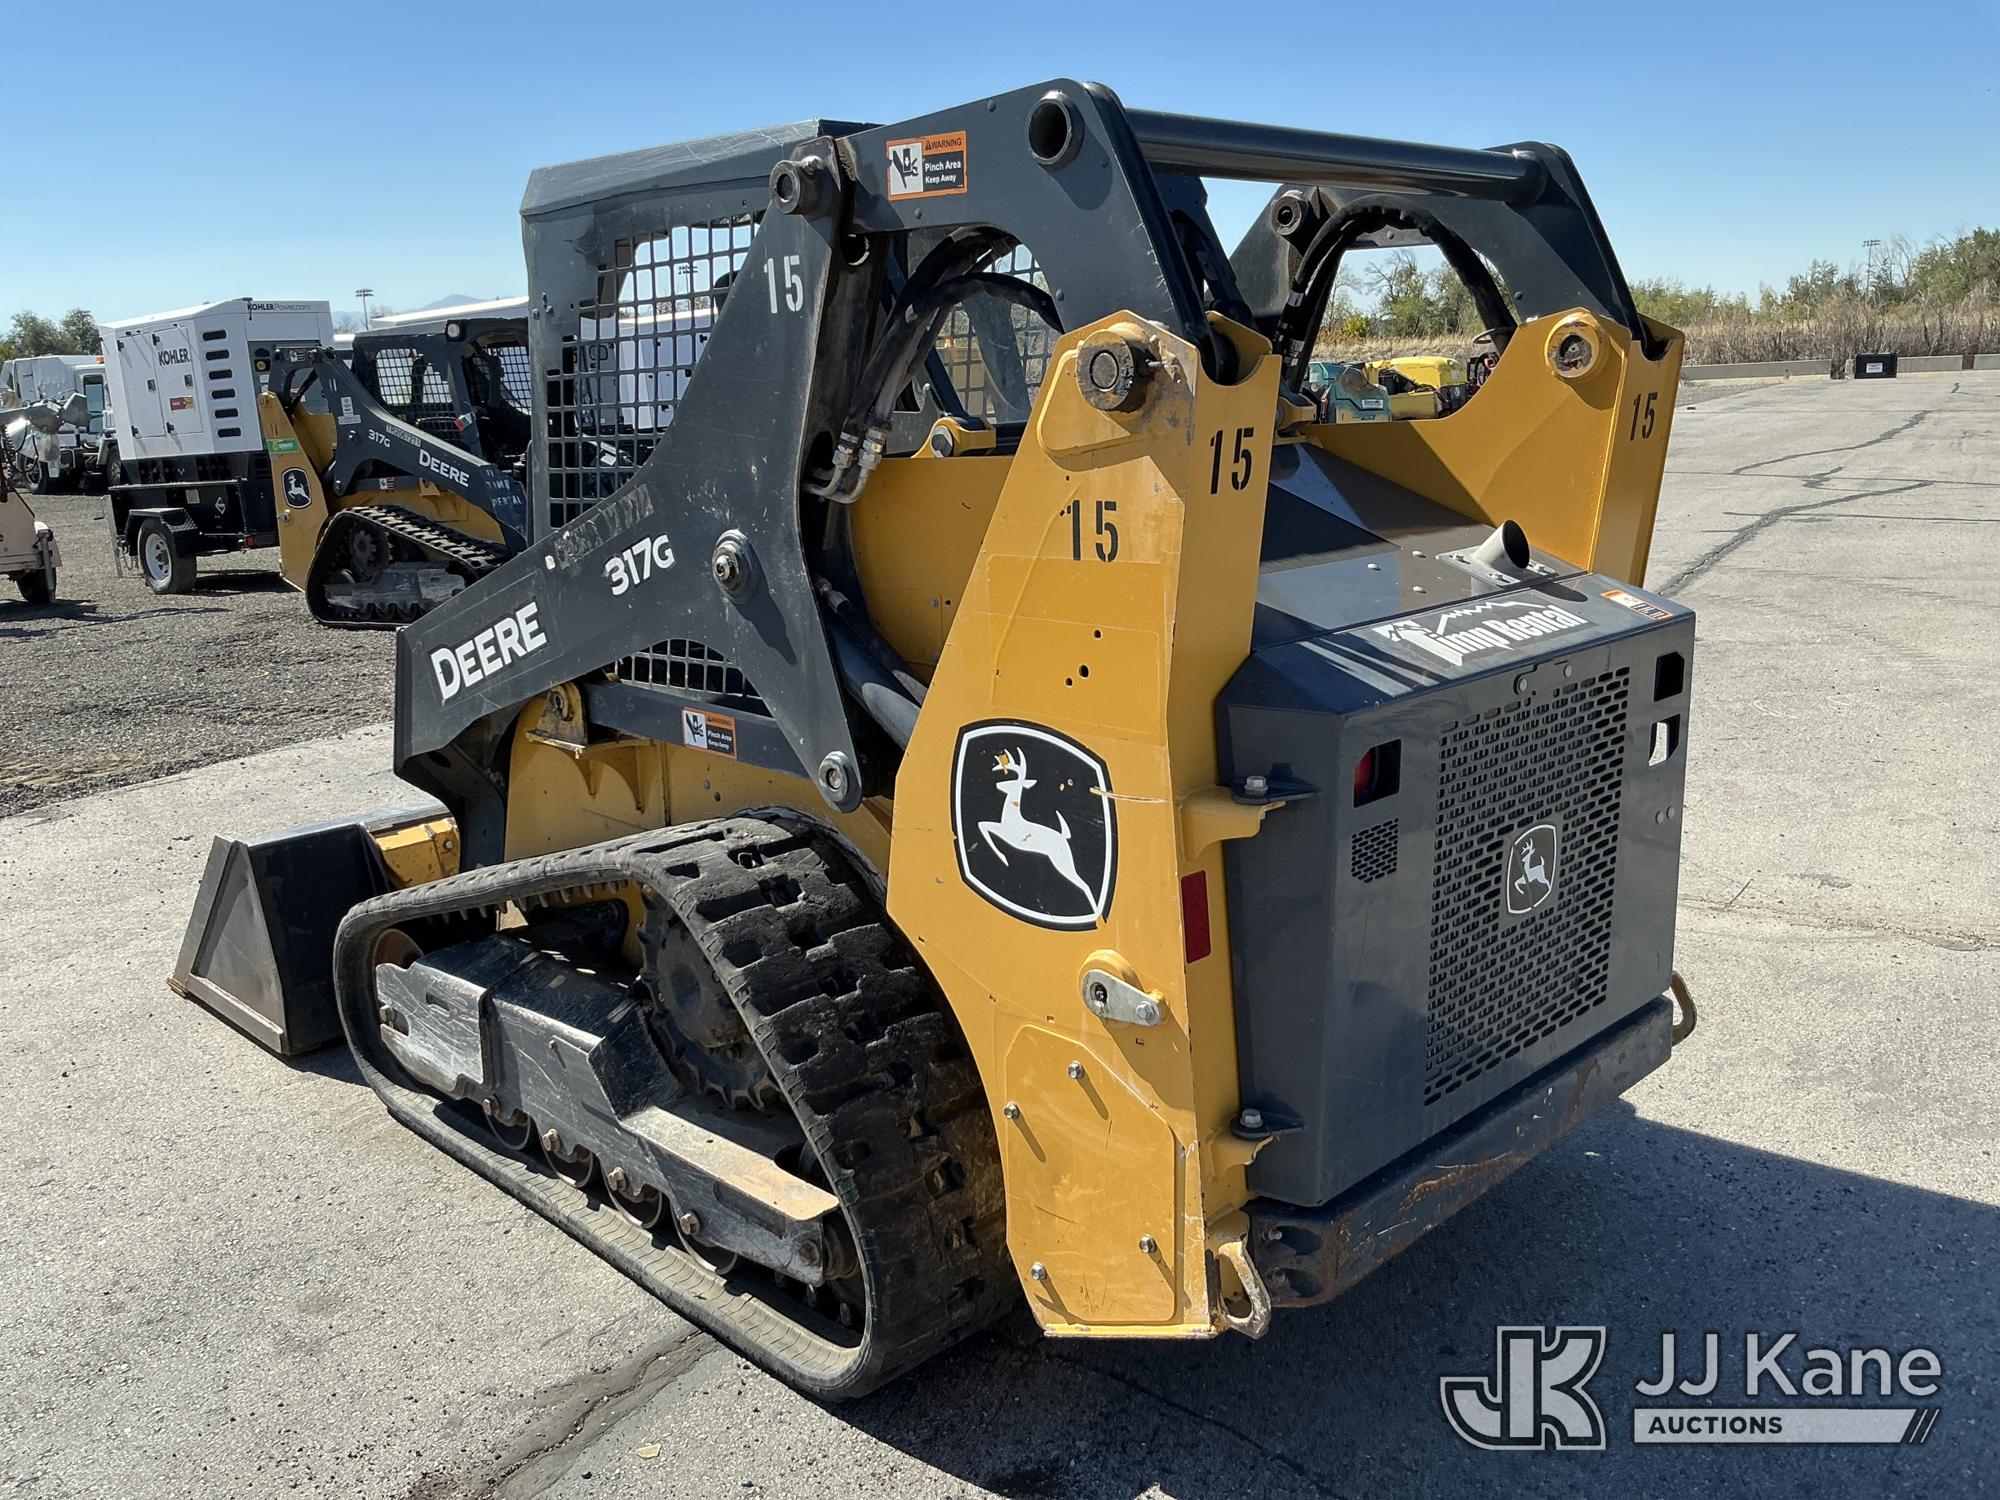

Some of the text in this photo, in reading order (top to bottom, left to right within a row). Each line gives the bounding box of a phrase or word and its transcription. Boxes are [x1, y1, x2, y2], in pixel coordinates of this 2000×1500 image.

[924, 160, 962, 172] Pinch Area
[931, 138, 962, 149] WARNING
[925, 174, 957, 185] Keep Away
[763, 254, 804, 314] 15
[158, 347, 190, 367] KOHLER
[368, 429, 391, 448] 317G
[1629, 391, 1659, 442] 15
[419, 448, 470, 488] DEERE
[1209, 426, 1255, 495] 15
[1066, 499, 1119, 563] 15
[604, 534, 676, 596] 317G
[430, 601, 548, 700] DEERE
